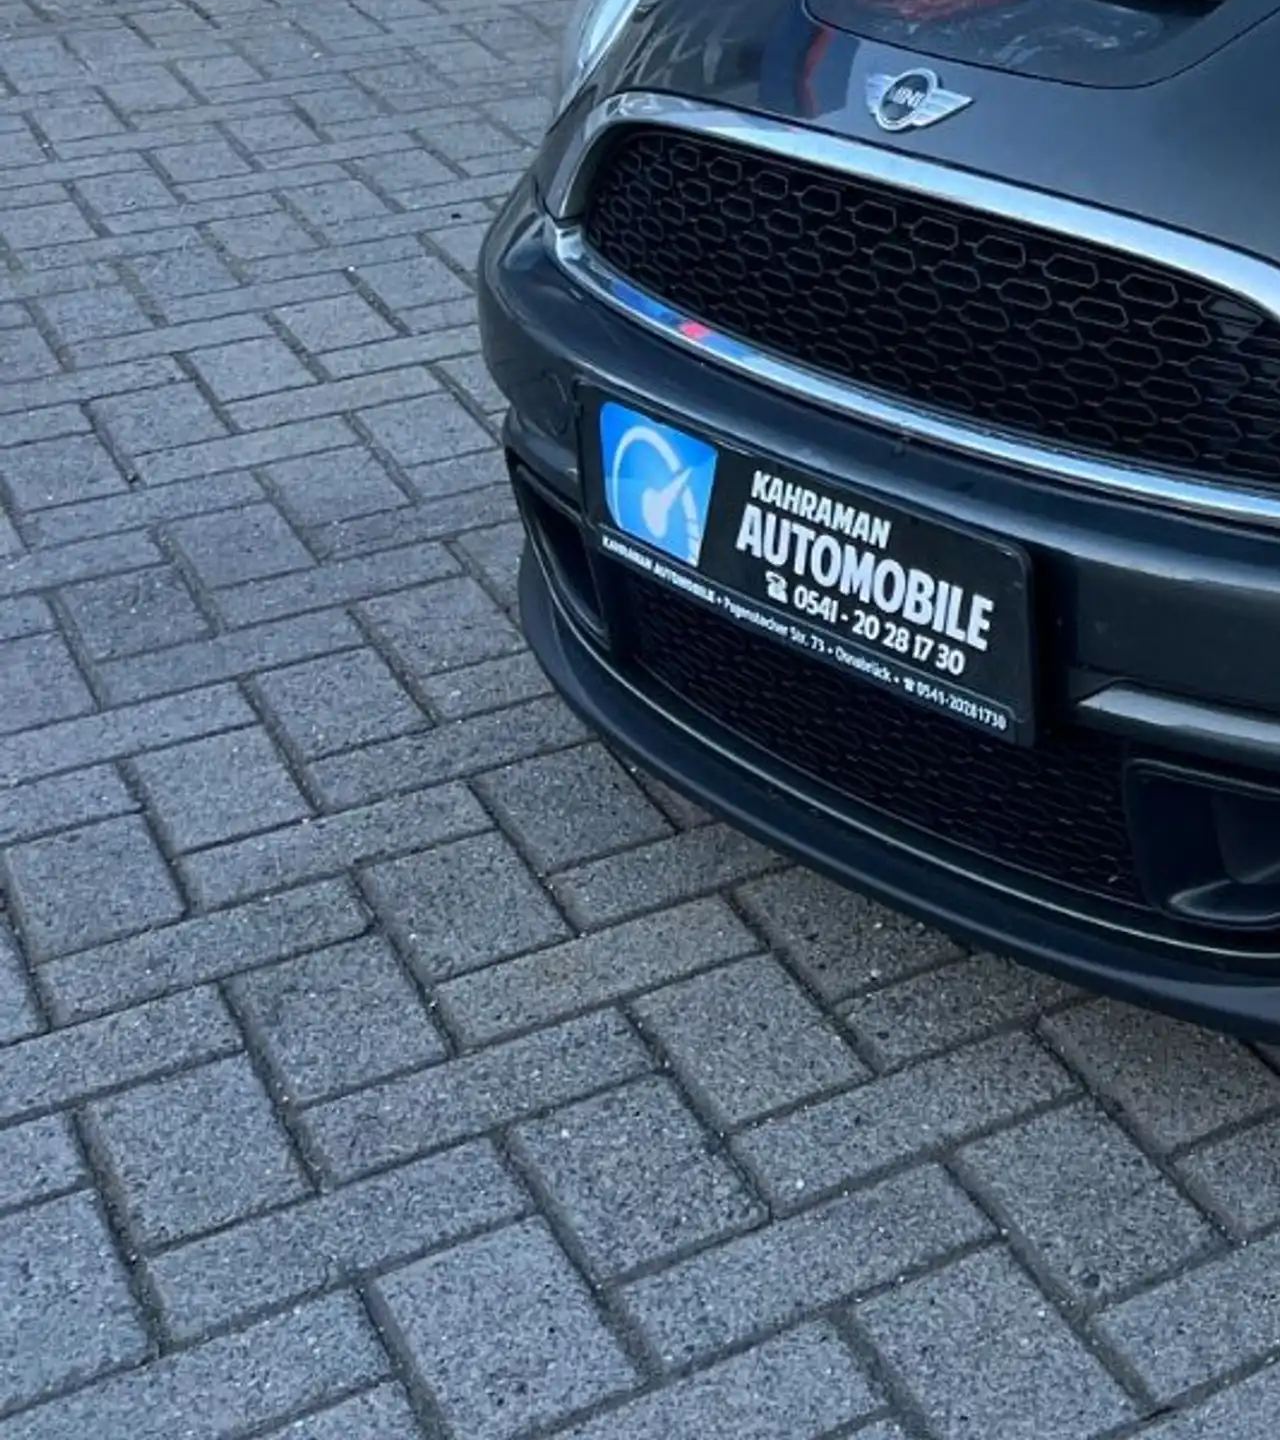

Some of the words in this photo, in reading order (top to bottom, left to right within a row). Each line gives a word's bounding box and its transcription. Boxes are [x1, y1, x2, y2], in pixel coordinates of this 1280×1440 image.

[751, 470, 892, 549] KAHRAMAN
[653, 564, 715, 604] AUTOMOBILE
[736, 503, 995, 652] AUTOMOBILE
[794, 585, 838, 623] 0541
[852, 610, 879, 640] 20
[882, 623, 910, 654] 28
[913, 634, 935, 661] 17
[935, 644, 965, 675] 30
